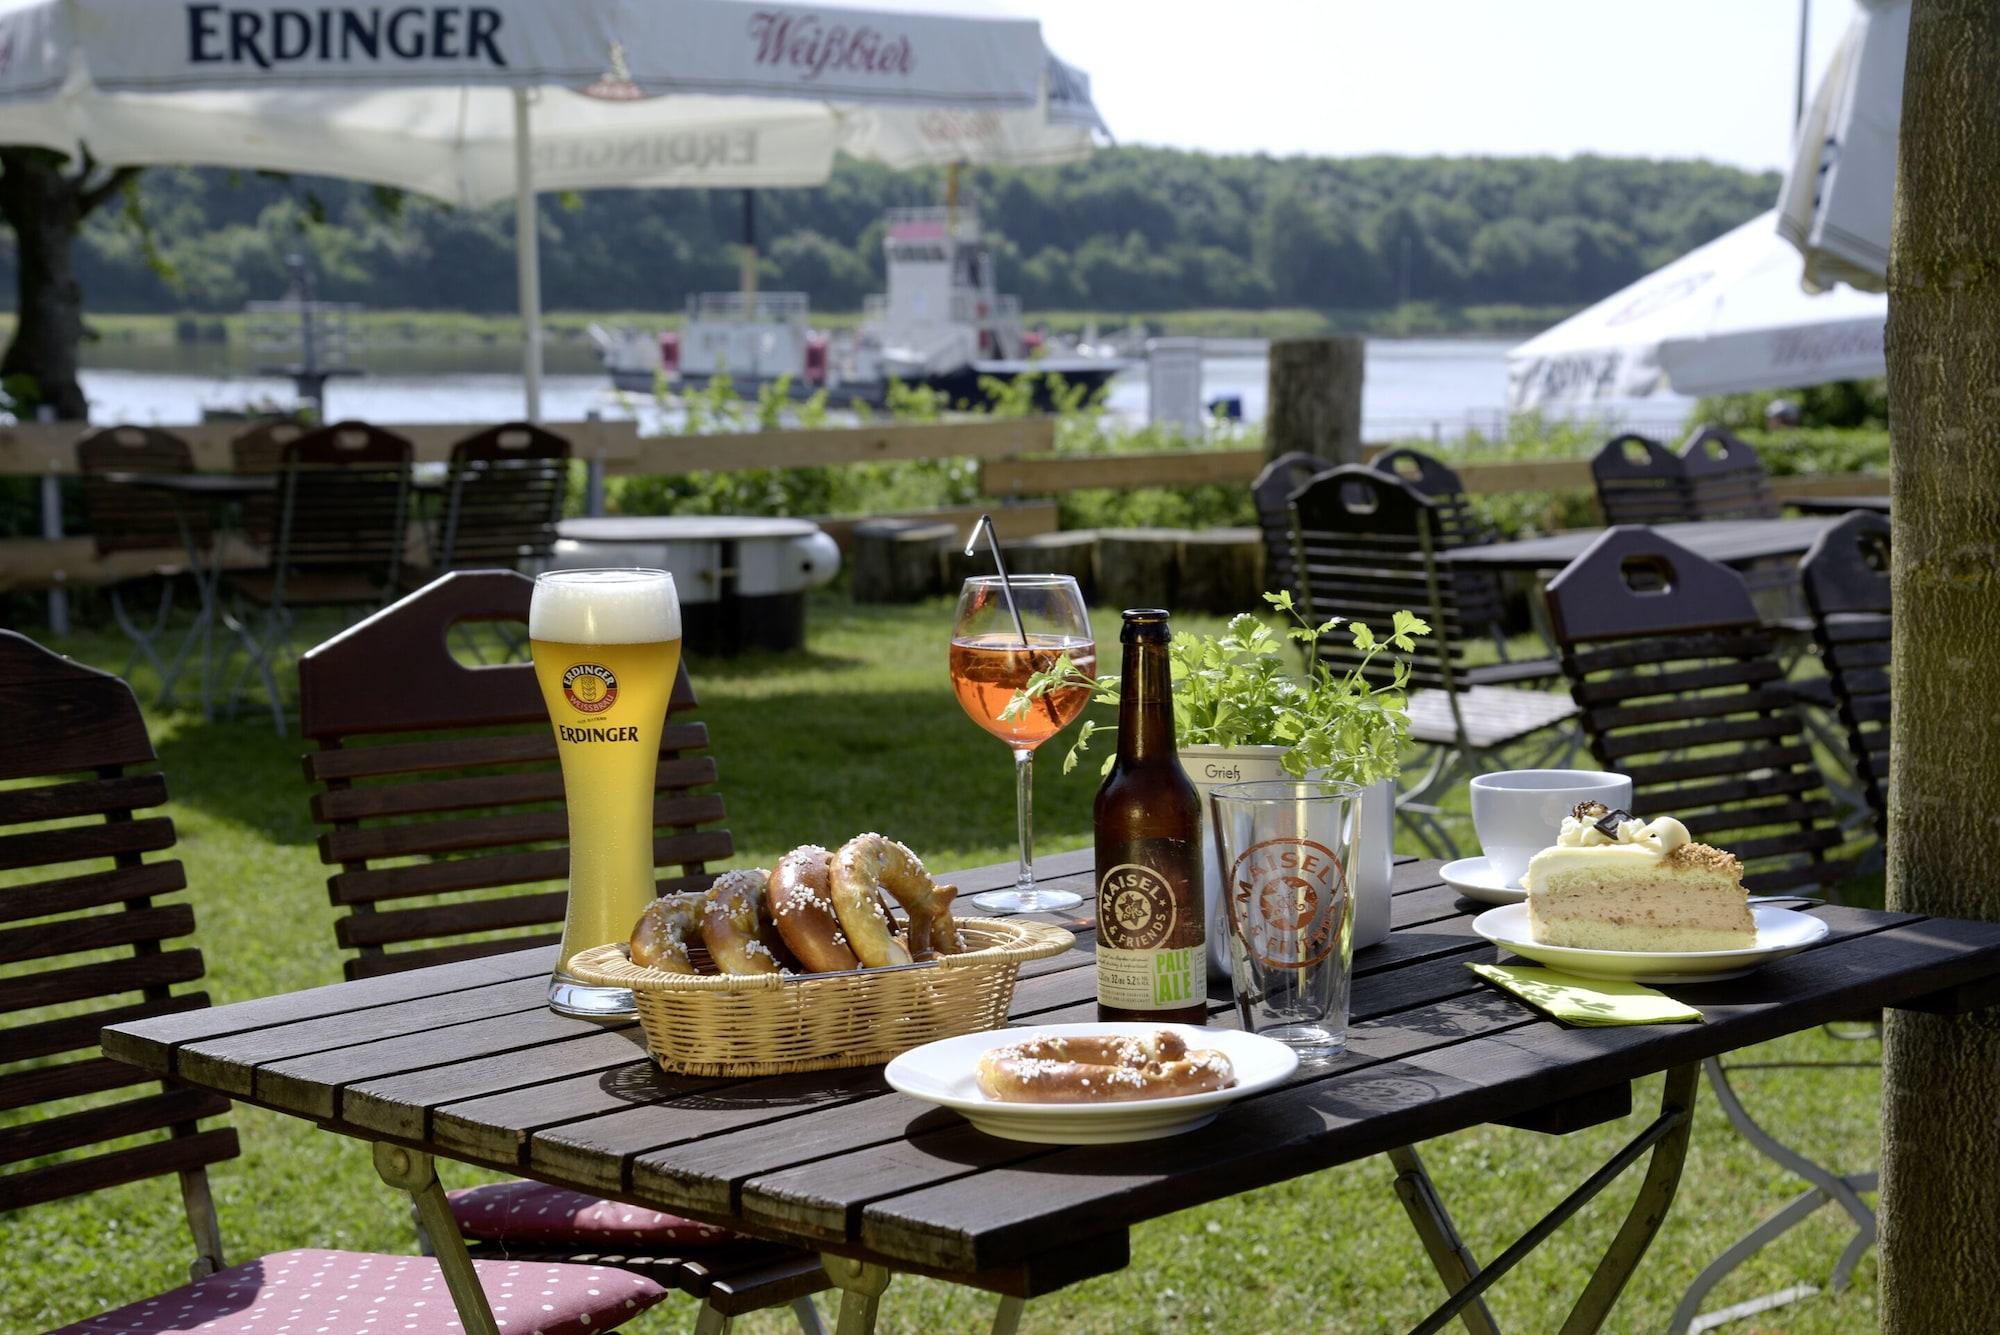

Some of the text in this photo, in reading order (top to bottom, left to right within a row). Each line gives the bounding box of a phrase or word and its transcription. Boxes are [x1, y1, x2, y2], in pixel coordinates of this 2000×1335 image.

[187, 4, 507, 69] ERDINGER
[748, 11, 914, 80] Weißbier
[563, 665, 615, 686] ERDINGER
[559, 724, 639, 744] ERDINGER
[1102, 874, 1161, 912] MAISEL
[1235, 851, 1330, 904] MAISEL
[1119, 913, 1166, 947] FRIENDS
[1156, 950, 1191, 974] PALE
[1160, 970, 1193, 1002] ALE
